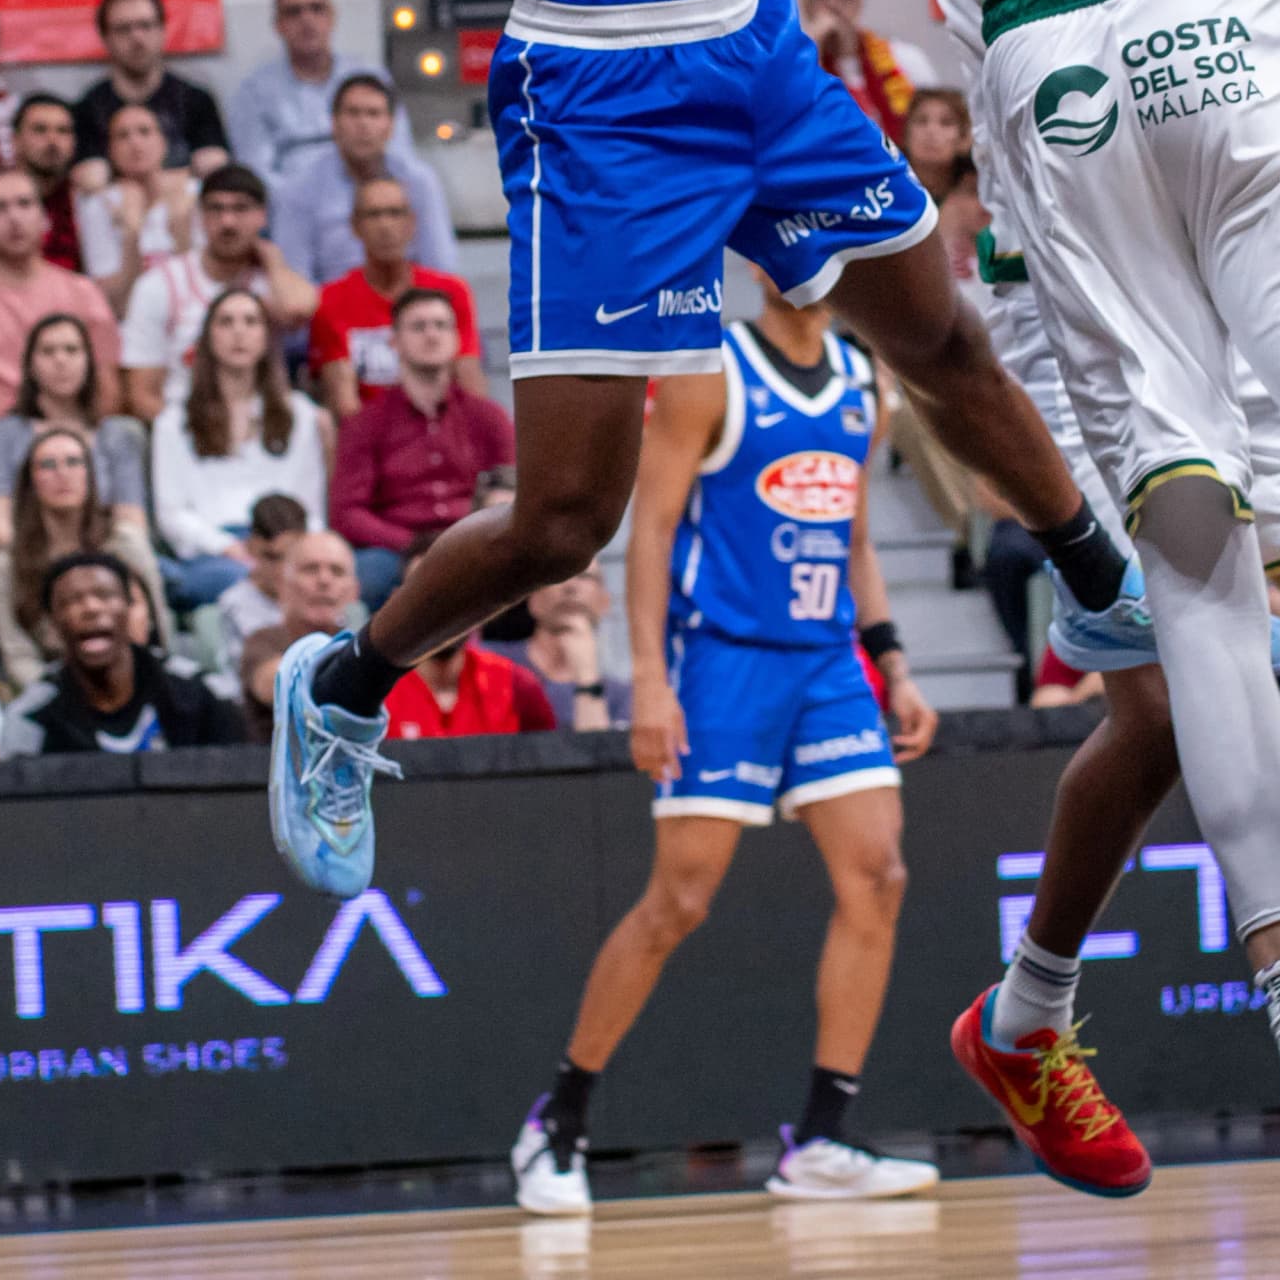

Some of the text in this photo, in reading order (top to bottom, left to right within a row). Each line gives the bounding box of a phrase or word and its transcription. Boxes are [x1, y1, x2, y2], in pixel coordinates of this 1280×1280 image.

[1121, 16, 1252, 69] COSTA
[1130, 50, 1256, 101] DEL SOL
[1136, 80, 1265, 131] MÁLAGA
[788, 561, 841, 621] 50
[141, 1036, 289, 1074] SHOES
